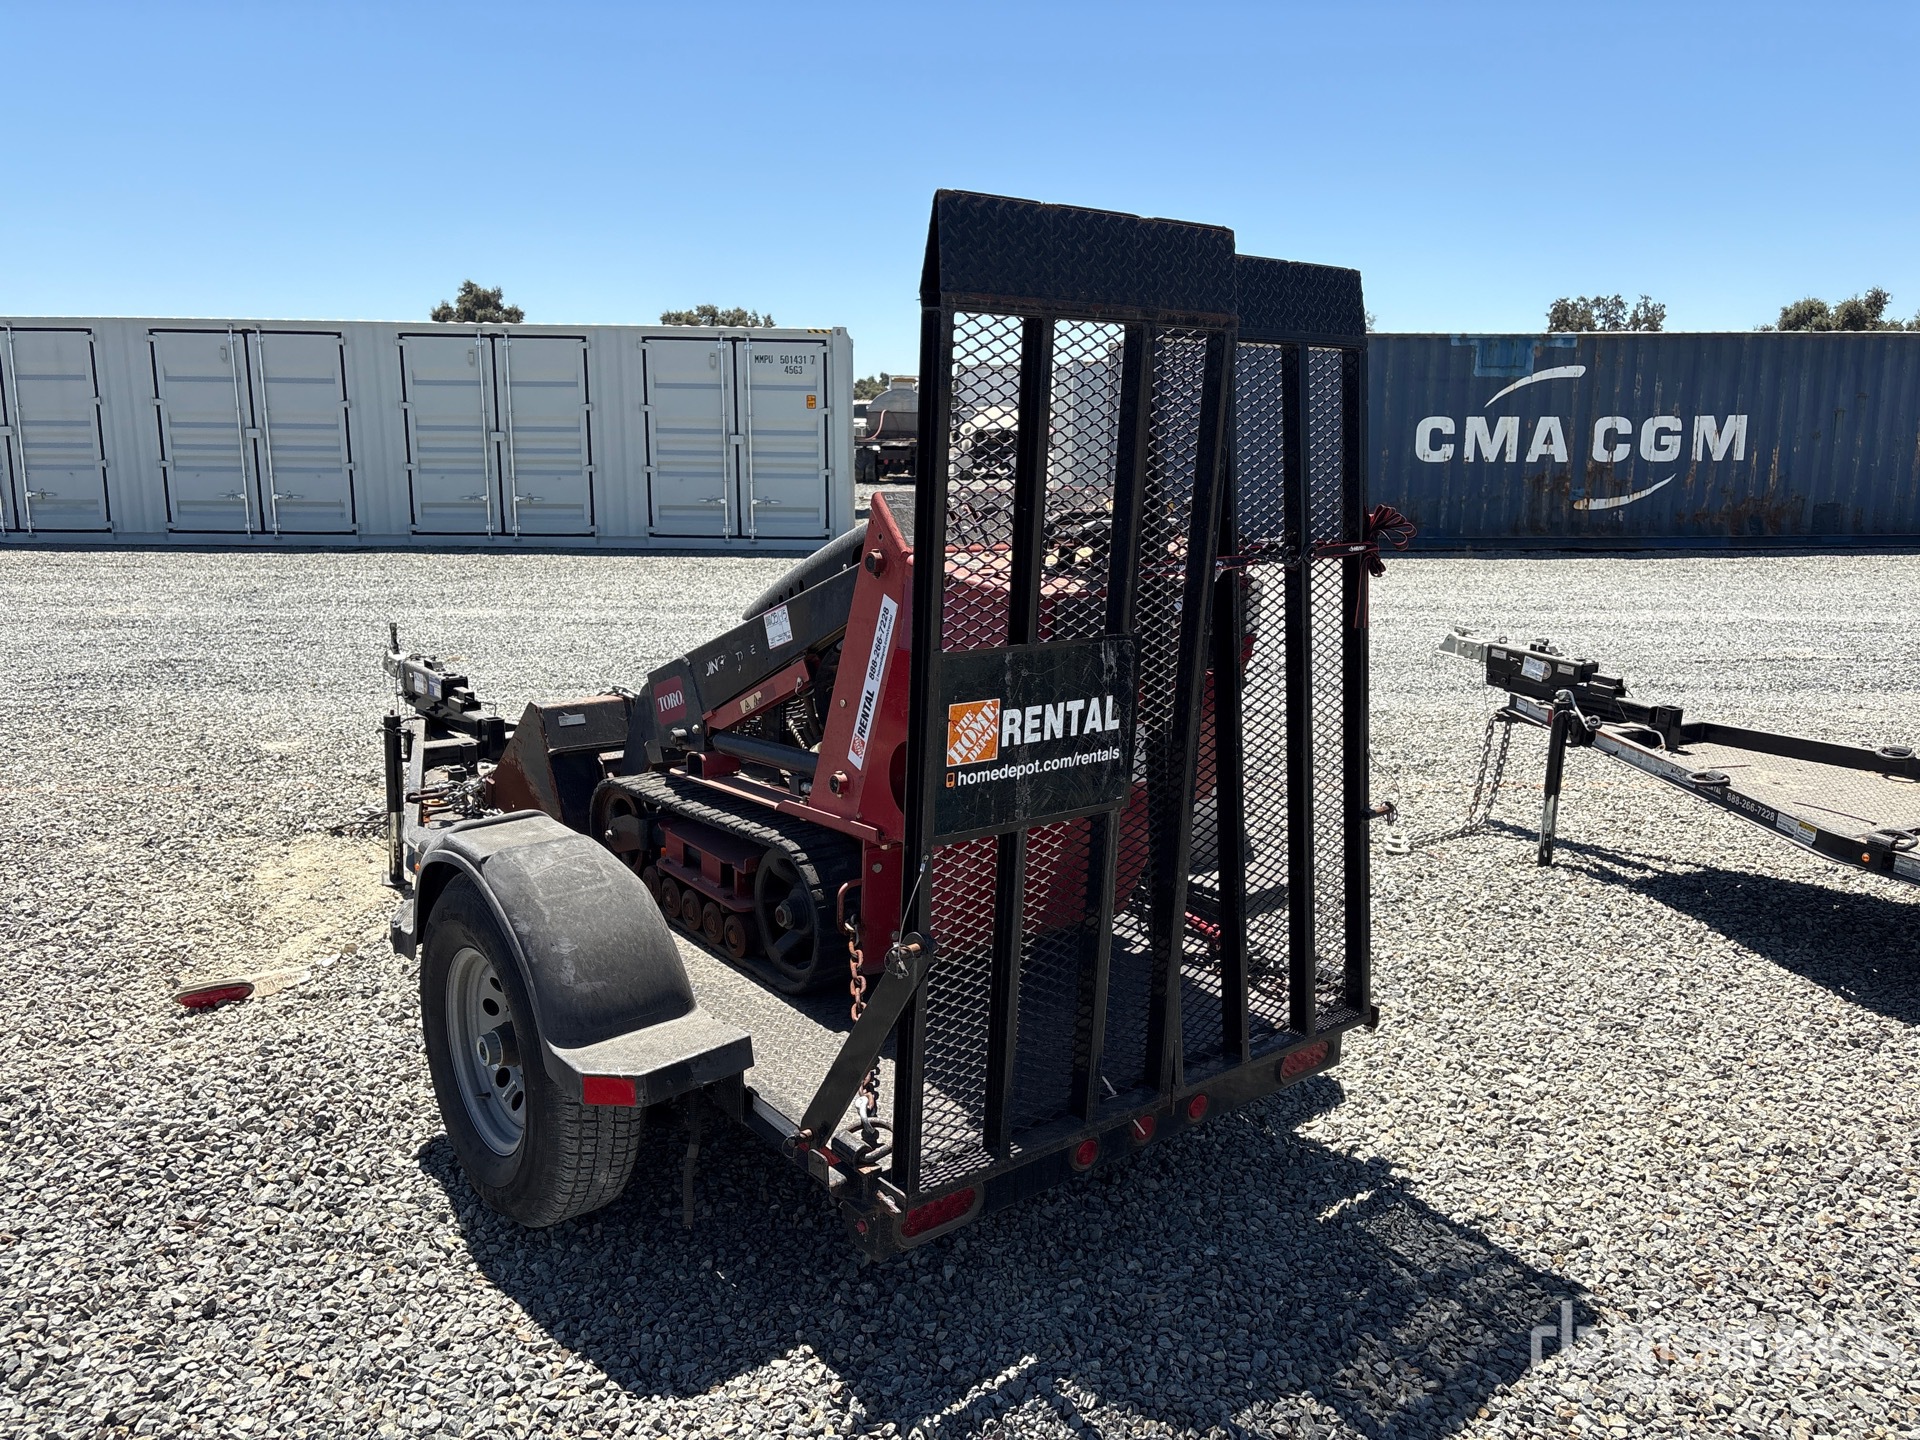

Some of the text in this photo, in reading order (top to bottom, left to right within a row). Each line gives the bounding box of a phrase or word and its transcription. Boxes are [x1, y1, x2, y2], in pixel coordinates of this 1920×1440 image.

[754, 355, 816, 365] MMPU 501431 7
[784, 365, 803, 375] 45G3
[1415, 414, 1748, 463] CMA CGM
[857, 690, 875, 739] RENTAL
[868, 606, 890, 681] 888-266-7228
[657, 690, 684, 713] TORO
[1001, 695, 1120, 747] RENTAL
[947, 700, 999, 765] HOME
[954, 709, 976, 735] THE
[967, 721, 999, 763] DEPOT
[957, 746, 1120, 786] homedepot.com/rentals
[1726, 792, 1776, 822] 888-266-7228
